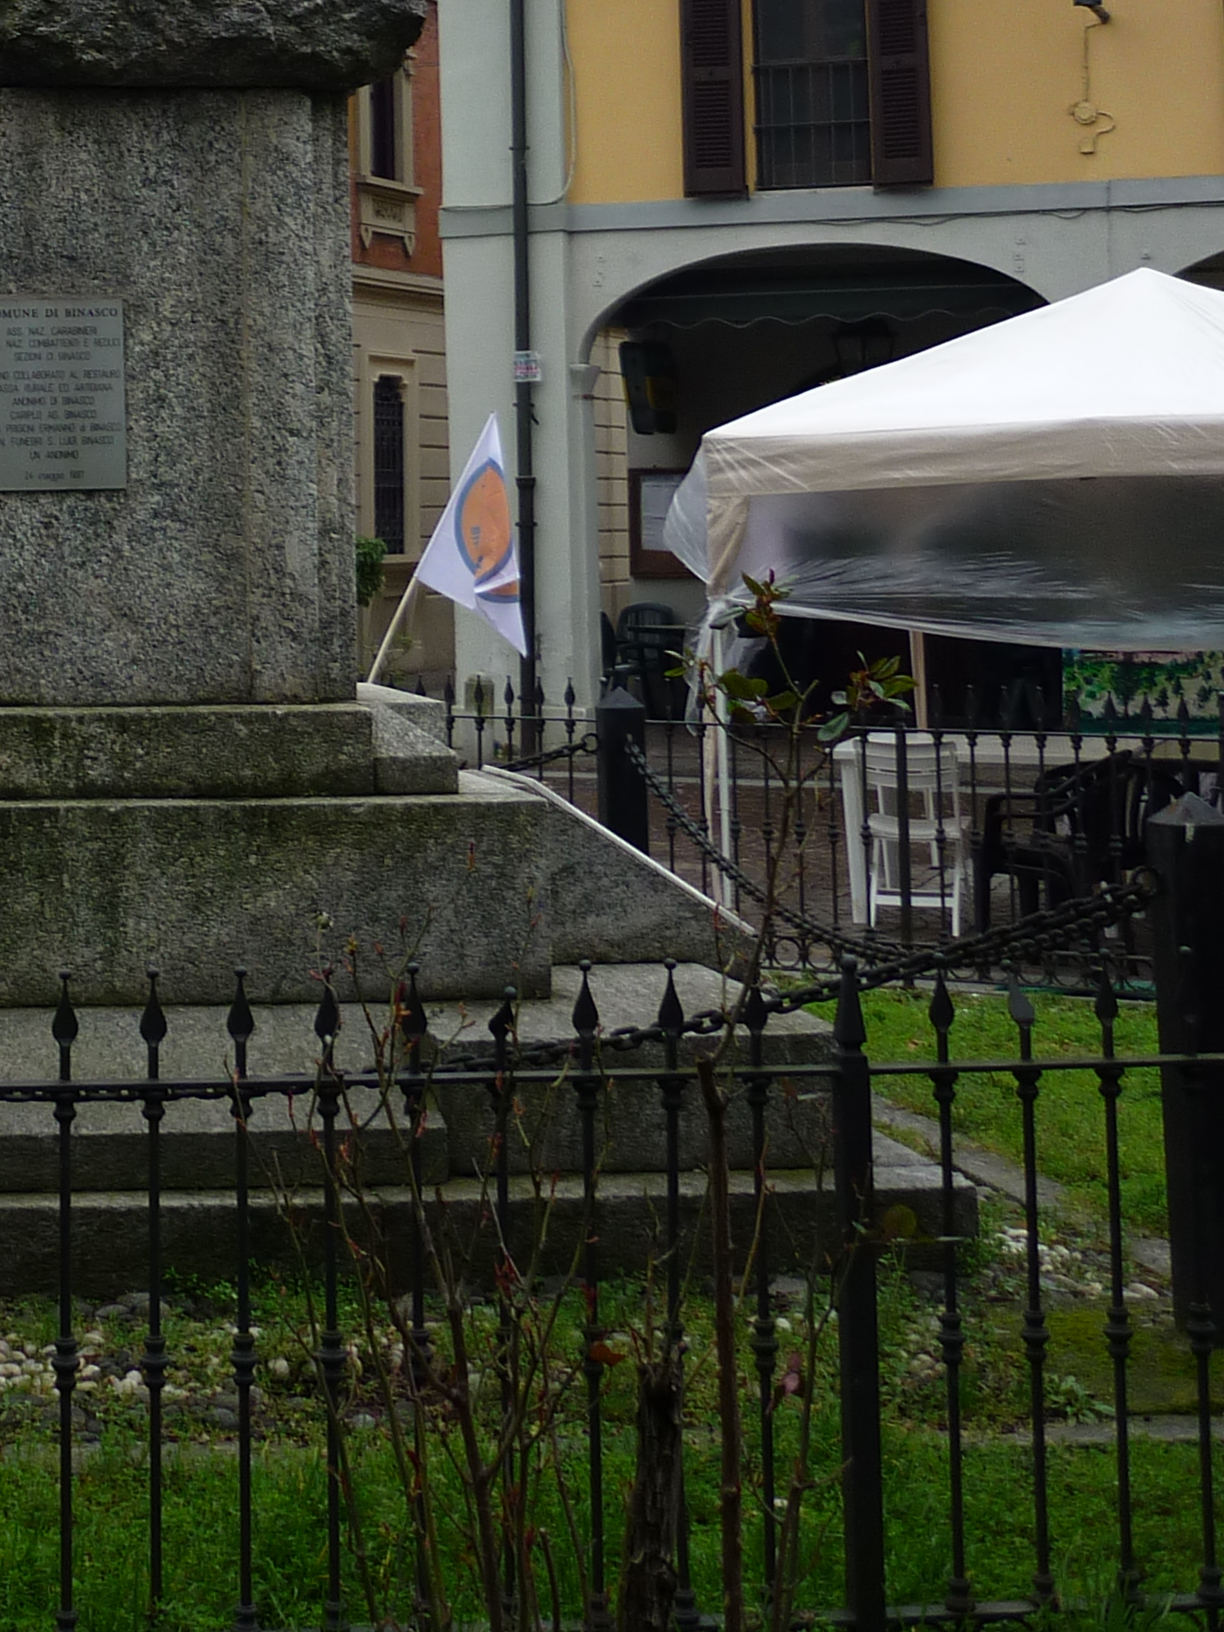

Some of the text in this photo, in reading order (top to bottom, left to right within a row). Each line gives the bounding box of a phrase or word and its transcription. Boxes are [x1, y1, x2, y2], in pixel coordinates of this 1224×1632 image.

[45, 308, 59, 318] DI
[65, 308, 118, 318] BINASCO
[50, 326, 97, 336] CARABINIERI
[83, 338, 89, 348] E
[58, 352, 91, 361] BINASCO
[14, 370, 65, 379] COLLABORATO
[70, 370, 78, 379] AL
[83, 370, 120, 379] RESTAURO
[58, 383, 69, 393] ED
[62, 396, 95, 405] BINASCO
[64, 410, 97, 419] BINASCO
[90, 423, 121, 433] BINASCO
[81, 436, 114, 446] BINASCO
[46, 450, 79, 460] ANONIMO
